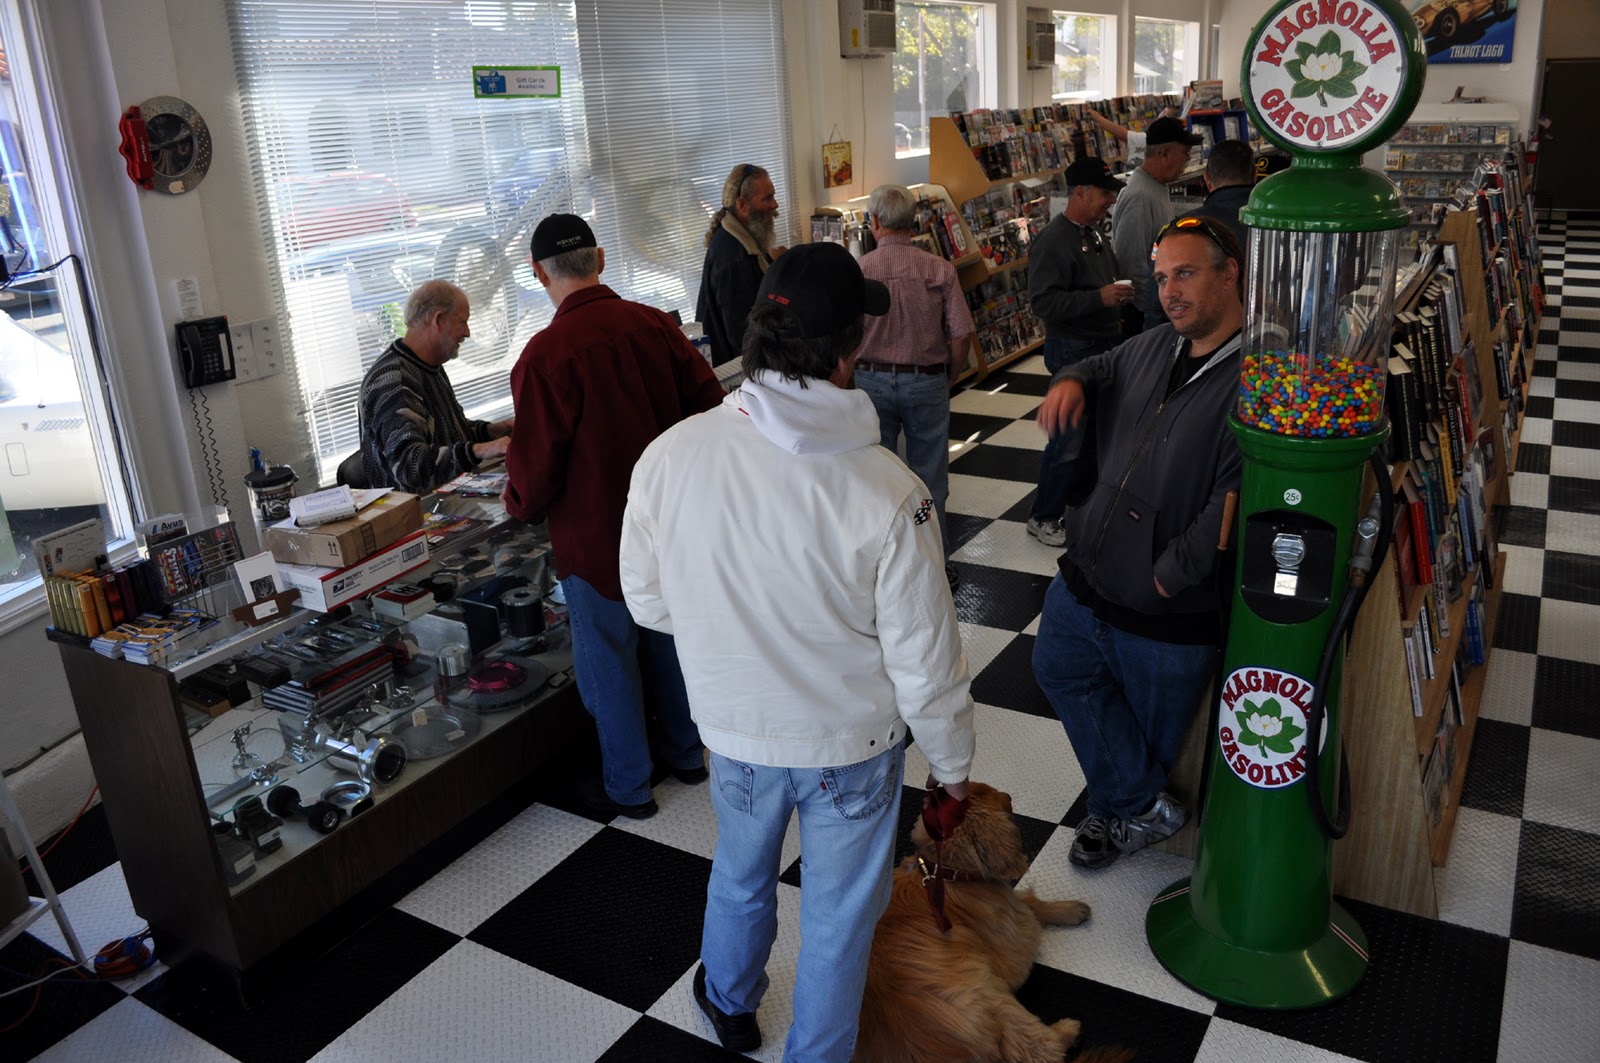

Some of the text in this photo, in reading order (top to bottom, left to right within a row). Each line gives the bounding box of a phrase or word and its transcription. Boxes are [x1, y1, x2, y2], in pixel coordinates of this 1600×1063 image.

[1257, 0, 1396, 67] MAGNOLIA
[1261, 85, 1388, 141] GASOLINE
[1222, 670, 1313, 720] MAGNOL
[1220, 726, 1307, 785] GASOLIN
